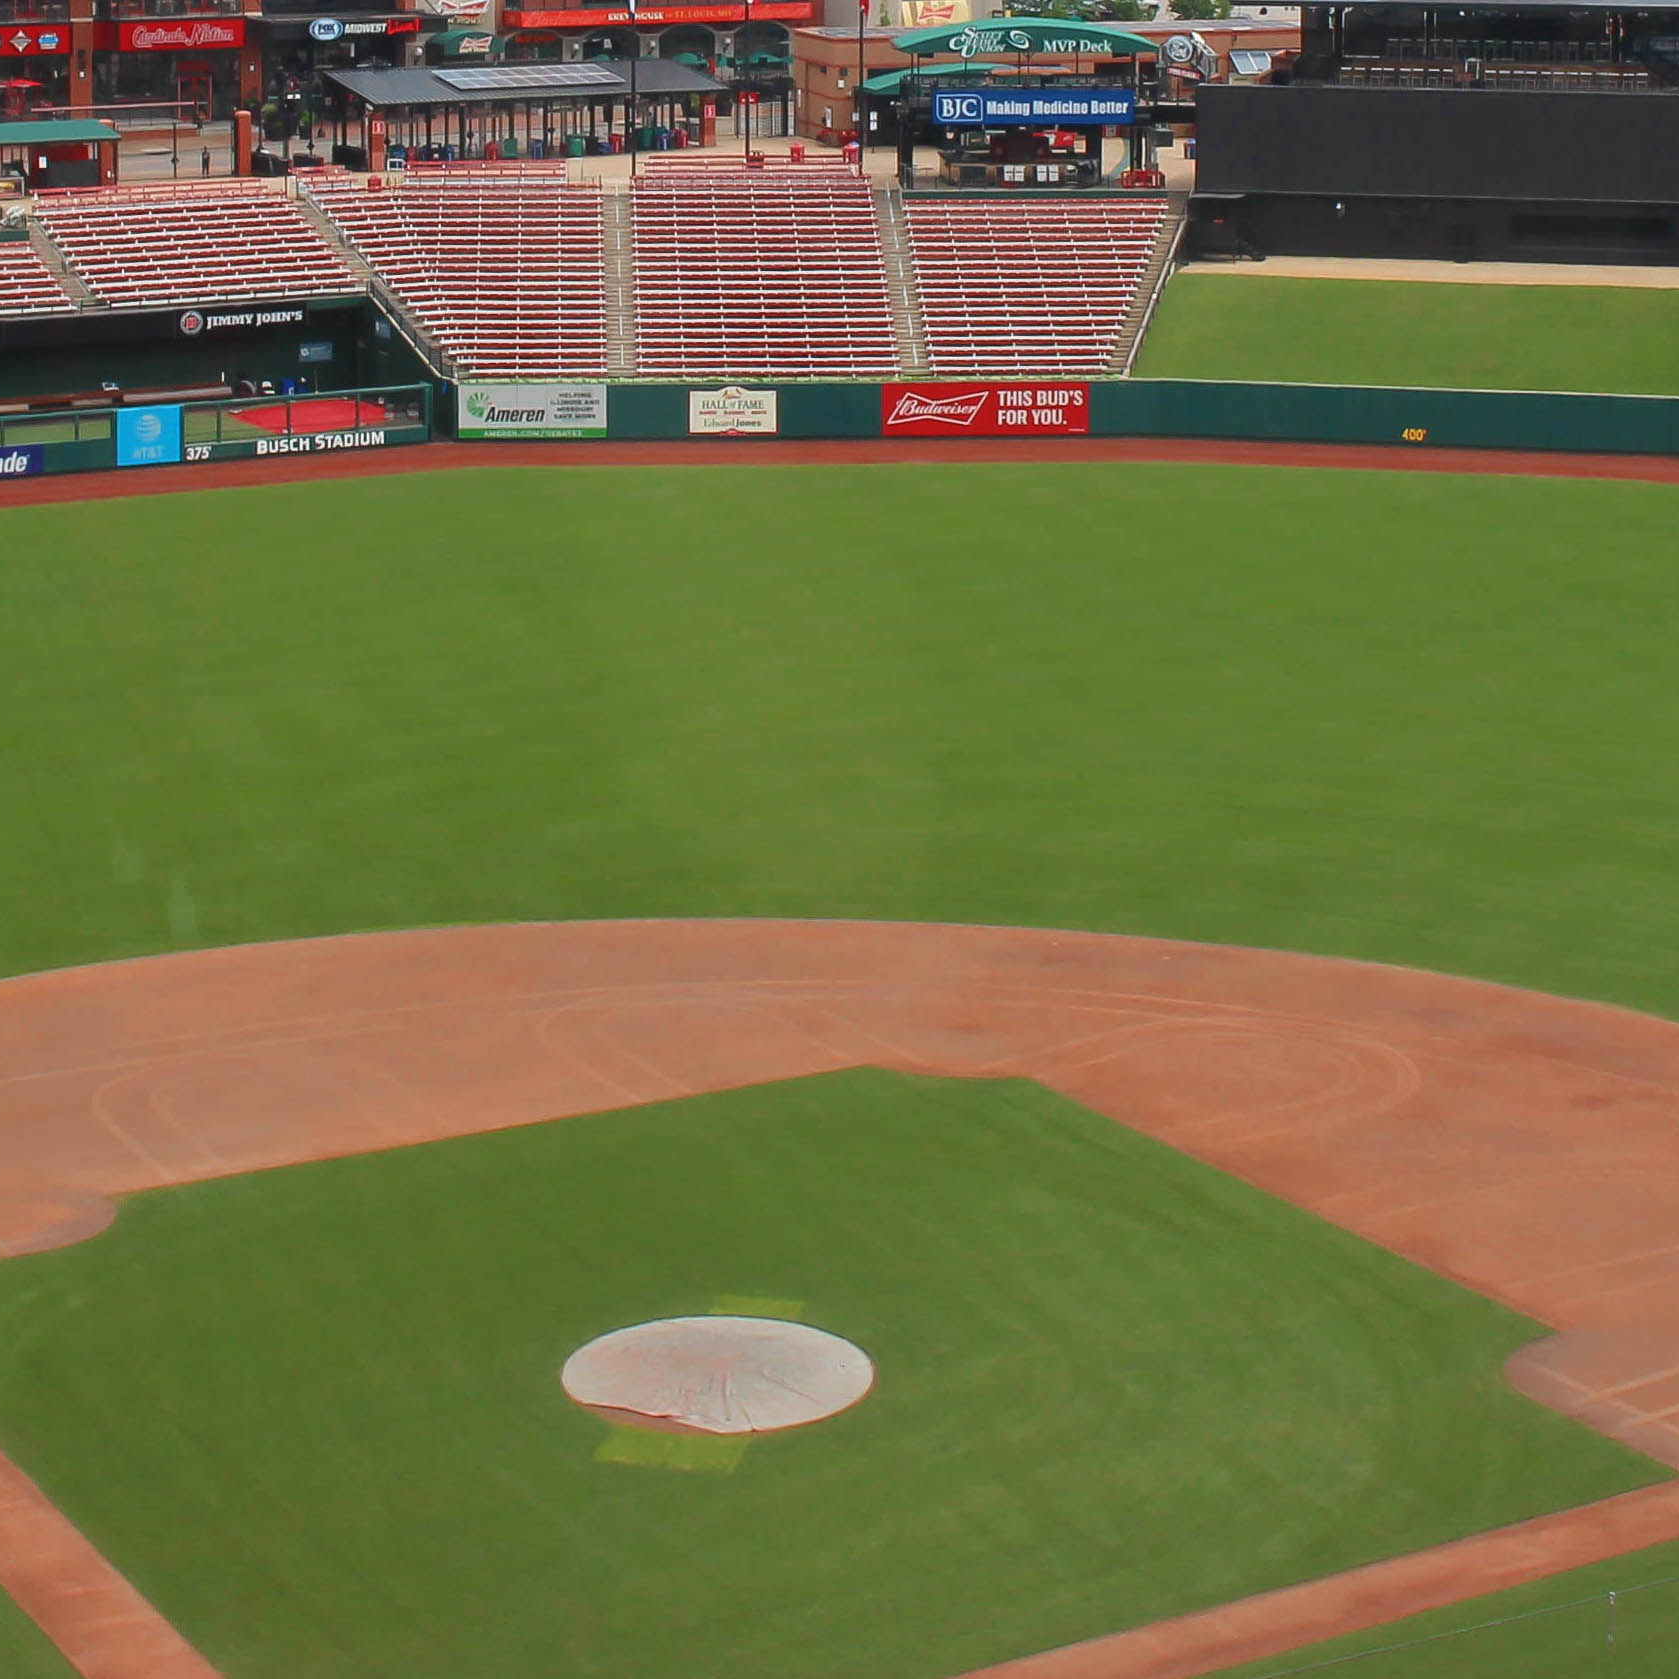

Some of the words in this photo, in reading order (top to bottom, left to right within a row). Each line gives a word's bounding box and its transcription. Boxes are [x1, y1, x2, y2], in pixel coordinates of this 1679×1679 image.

[131, 26, 187, 48] Cardinals
[185, 24, 235, 46] Nation
[344, 22, 387, 34] MIDWEST
[1043, 39, 1076, 53] MVP
[1079, 39, 1112, 53] Deck
[942, 98, 978, 118] BJC
[986, 100, 1030, 116] Making
[1033, 99, 1088, 116] Medicine
[1090, 99, 1128, 115] Better
[206, 314, 254, 330] JIMMY
[256, 310, 303, 327] JOHN'S
[702, 400, 728, 409] HALL
[738, 400, 764, 409] FAME
[997, 390, 1030, 406] THIS
[1037, 389, 1084, 406] BUD'S
[485, 406, 545, 423] Ameren
[896, 399, 979, 416] Budweiser
[997, 410, 1027, 426] FOR
[1033, 409, 1067, 426] YOU.
[256, 436, 310, 456] BUSCH
[315, 430, 385, 451] STADIUM
[1401, 428, 1427, 441] 400'
[185, 445, 212, 461] 375'
